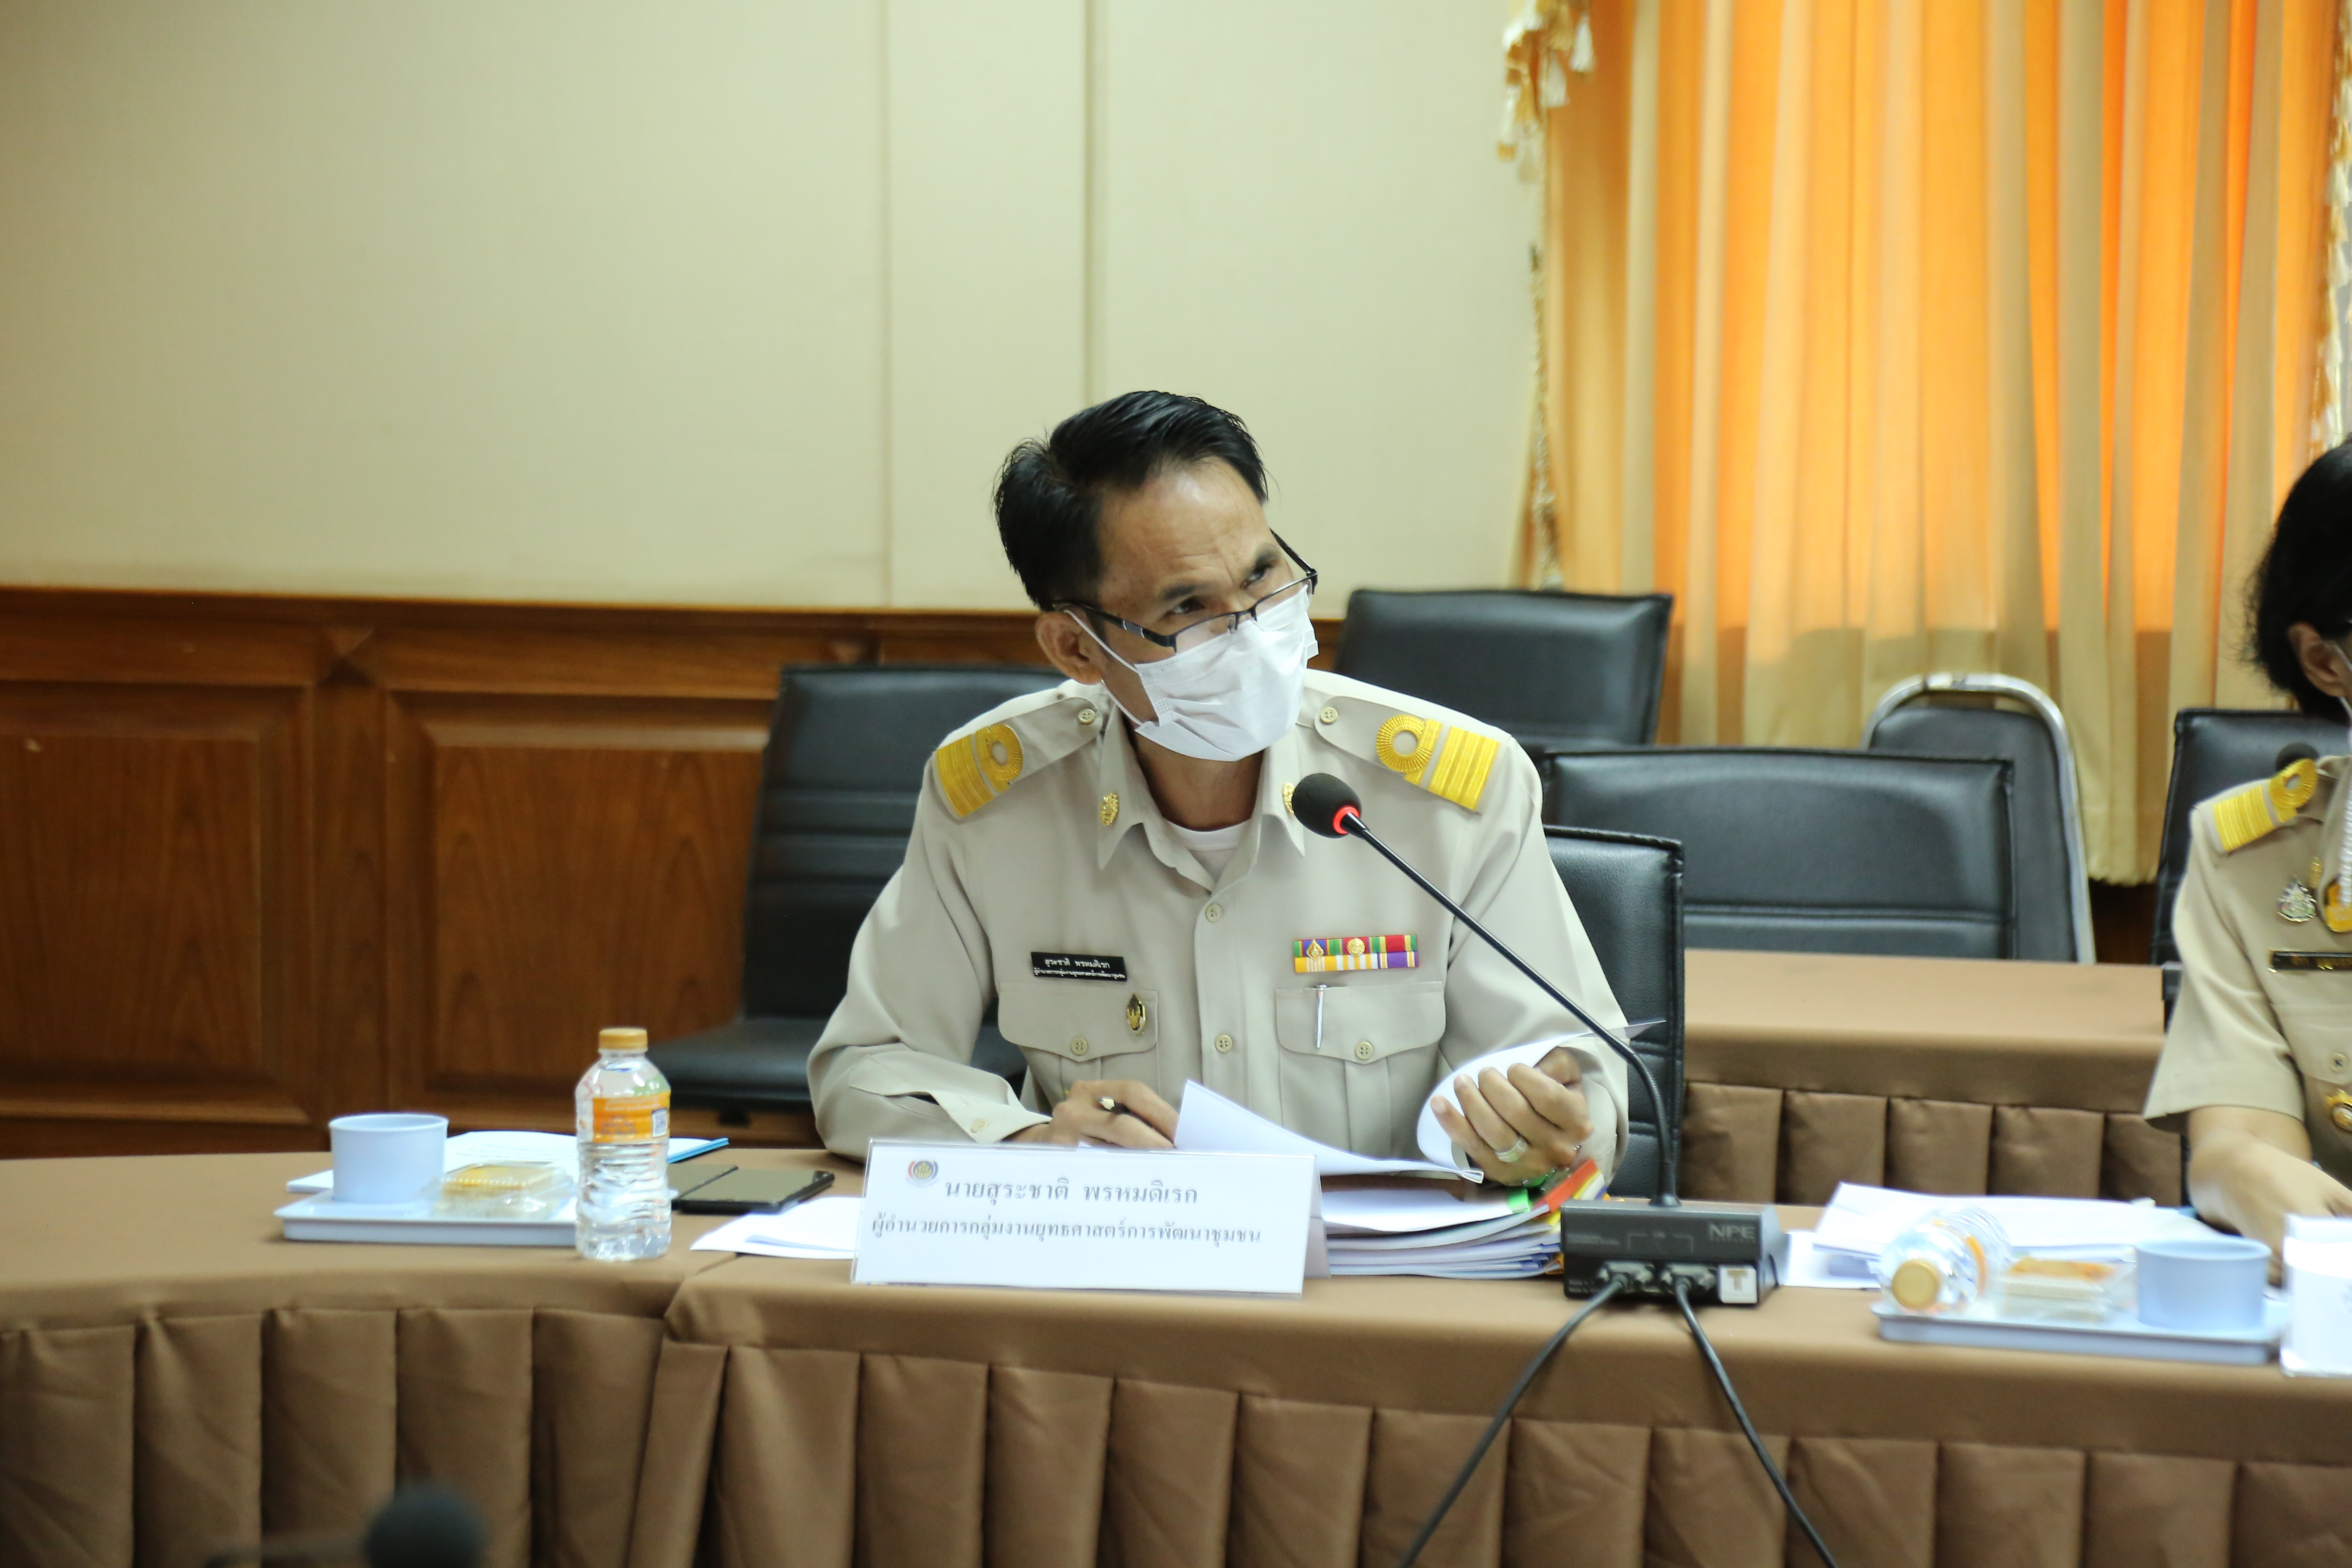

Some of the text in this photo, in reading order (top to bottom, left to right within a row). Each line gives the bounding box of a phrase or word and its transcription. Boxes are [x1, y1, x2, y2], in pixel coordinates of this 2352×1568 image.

[946, 1178, 1198, 1205] นายสุระชาติ พรหมดิเรก
[872, 1212, 1261, 1247] ผู้อำนวยการกลุ่มงานยุทธศาสตร์การพัฒนาชุมชน
[1709, 1224, 1755, 1239] NPE
